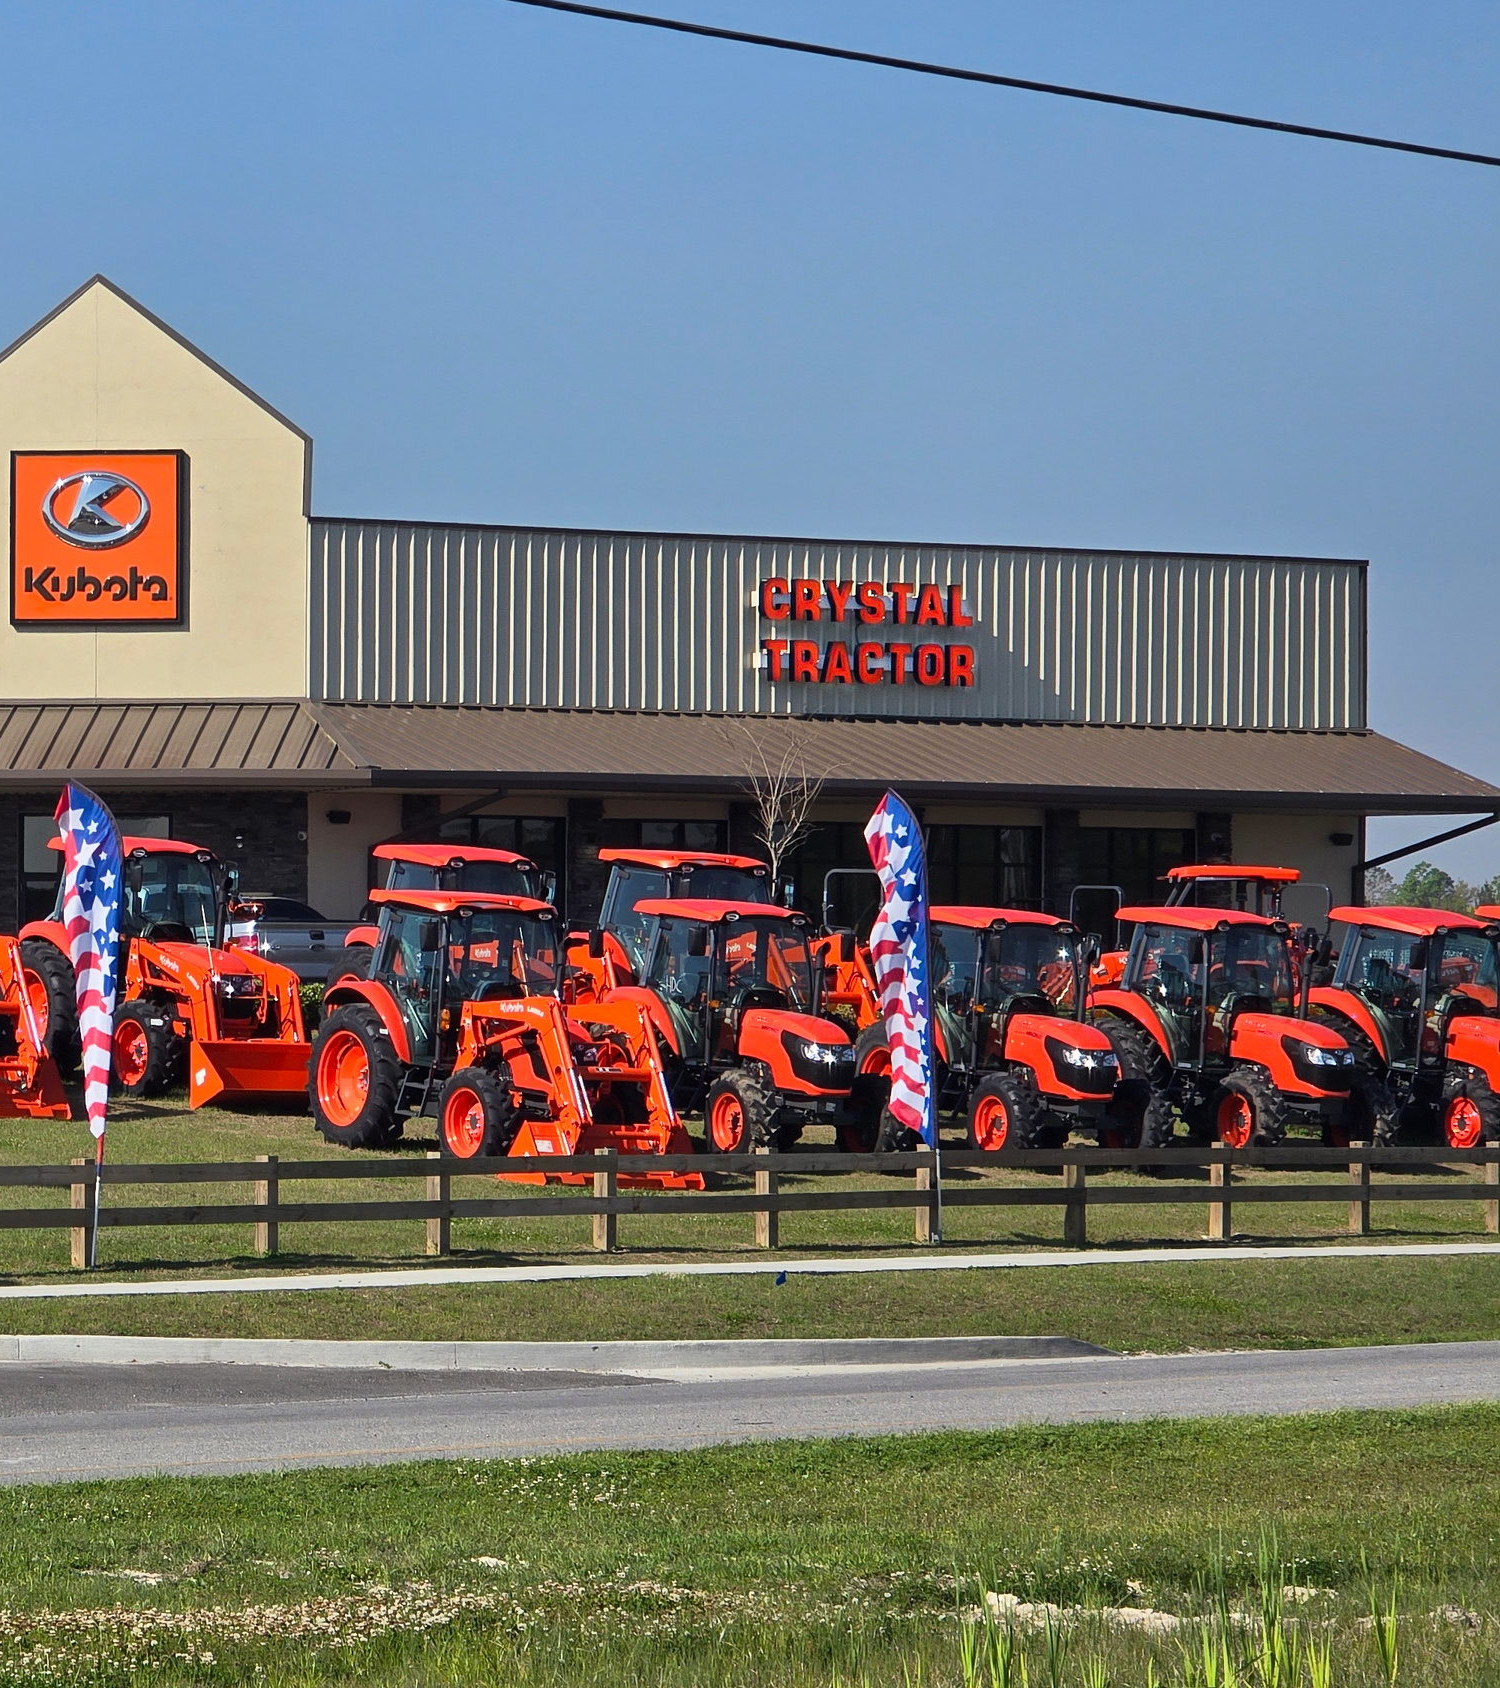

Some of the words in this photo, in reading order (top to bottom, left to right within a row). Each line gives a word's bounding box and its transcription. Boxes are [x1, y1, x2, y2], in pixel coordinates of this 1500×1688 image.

[24, 566, 169, 601] Kubota
[759, 577, 973, 627] CRYSTAL
[760, 639, 975, 687] TRACTOR
